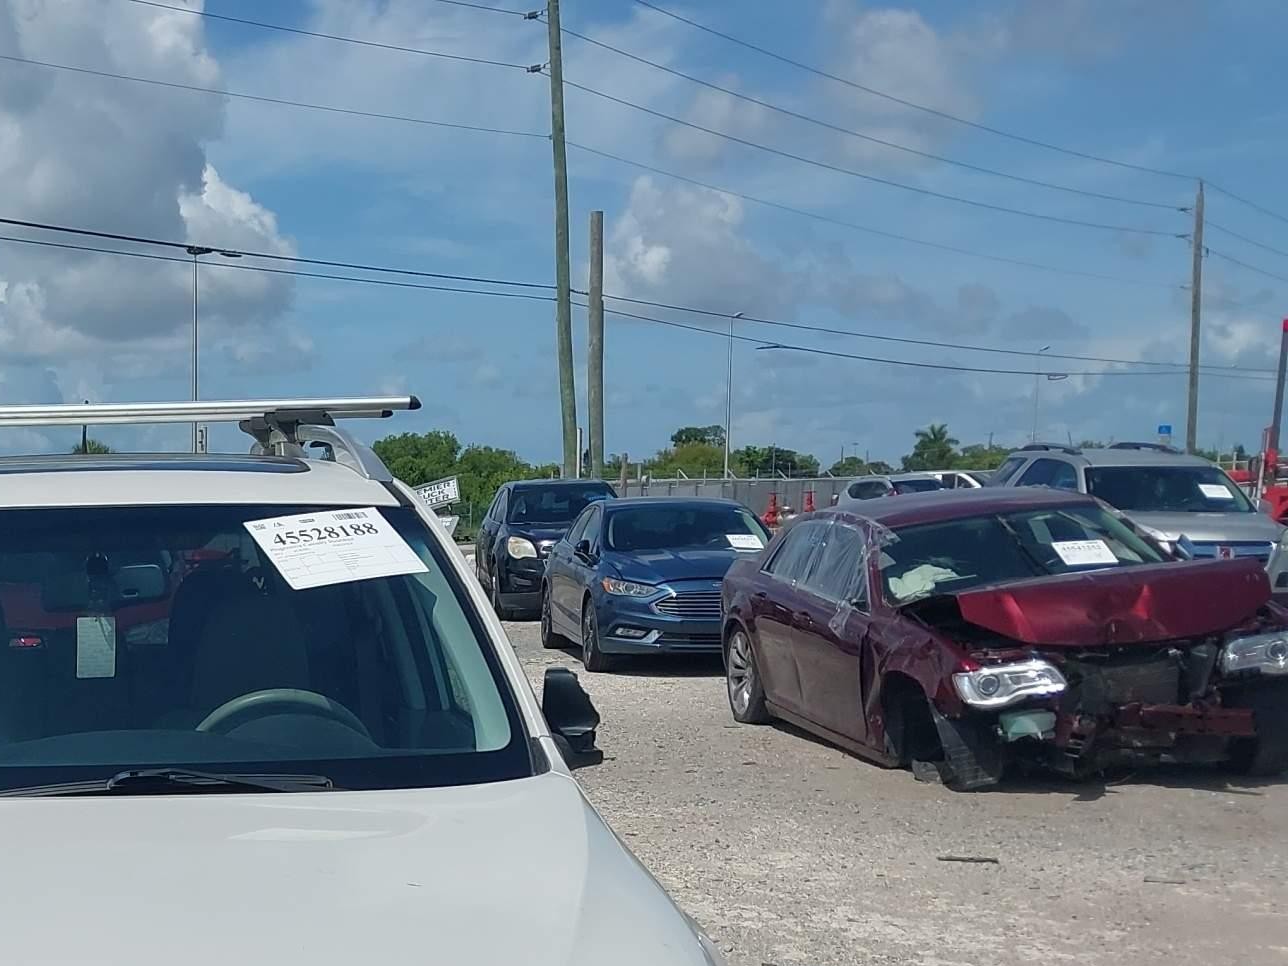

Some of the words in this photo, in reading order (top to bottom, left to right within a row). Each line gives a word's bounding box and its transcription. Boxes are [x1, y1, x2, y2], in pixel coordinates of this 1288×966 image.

[416, 482, 451, 496] EMIER
[422, 489, 446, 500] UCK
[425, 494, 450, 504] TER
[273, 522, 379, 545] 45528188
